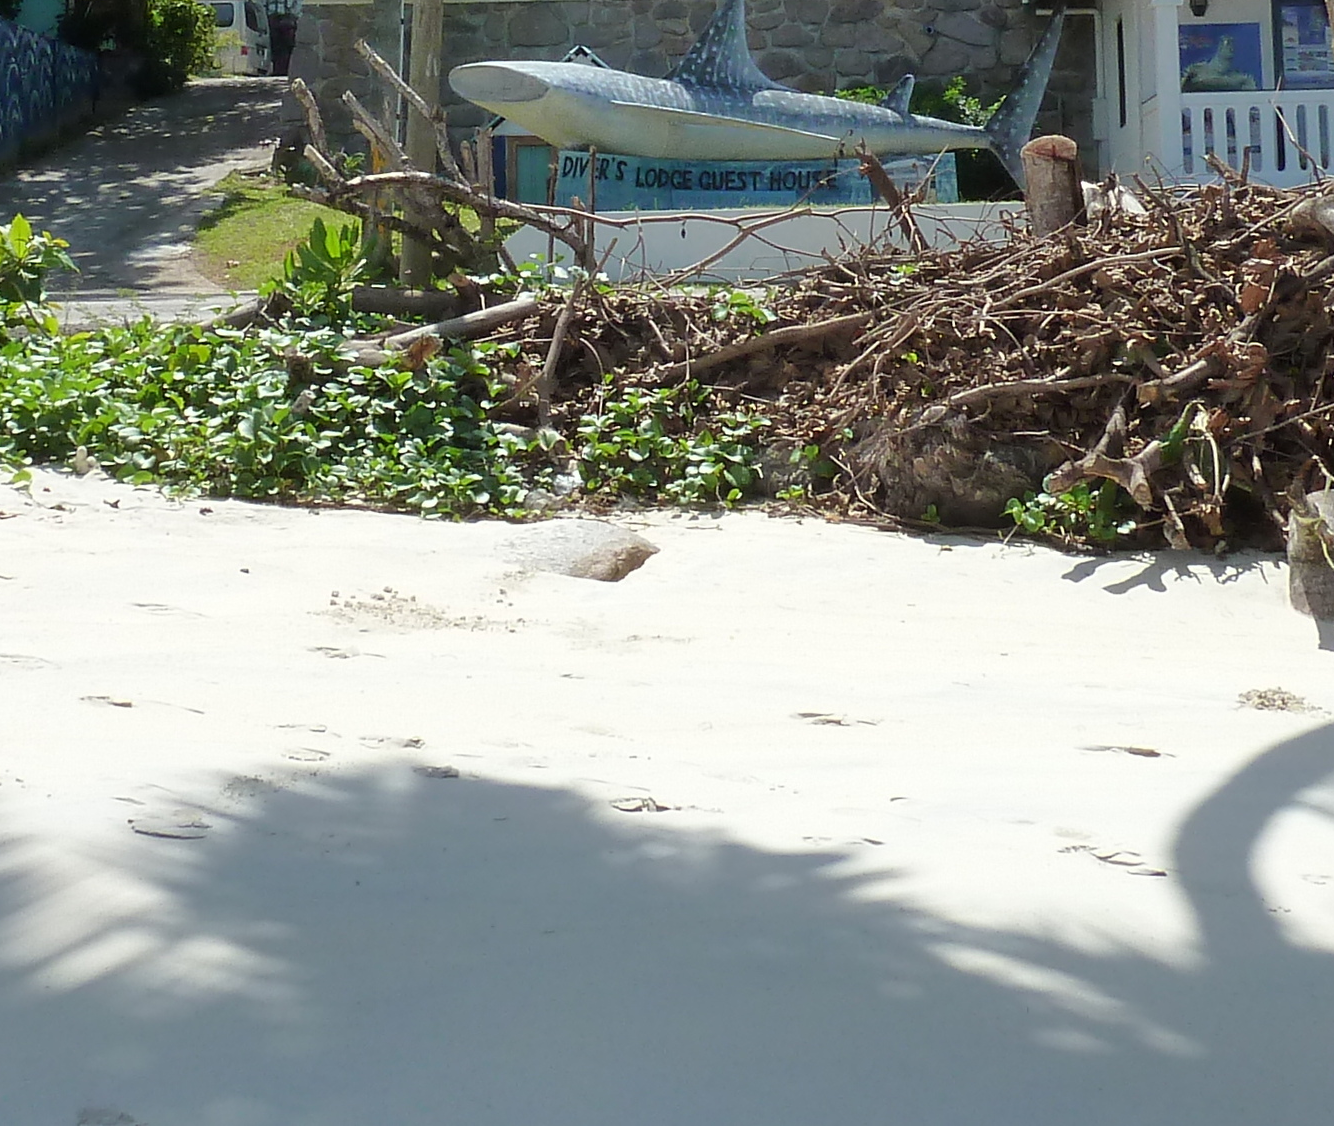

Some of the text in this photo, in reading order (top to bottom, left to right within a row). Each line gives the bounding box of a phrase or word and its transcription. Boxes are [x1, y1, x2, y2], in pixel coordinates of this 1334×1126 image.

[635, 166, 693, 189] LODGE
[699, 169, 760, 190] GUEST
[770, 168, 838, 191] HOUSE
